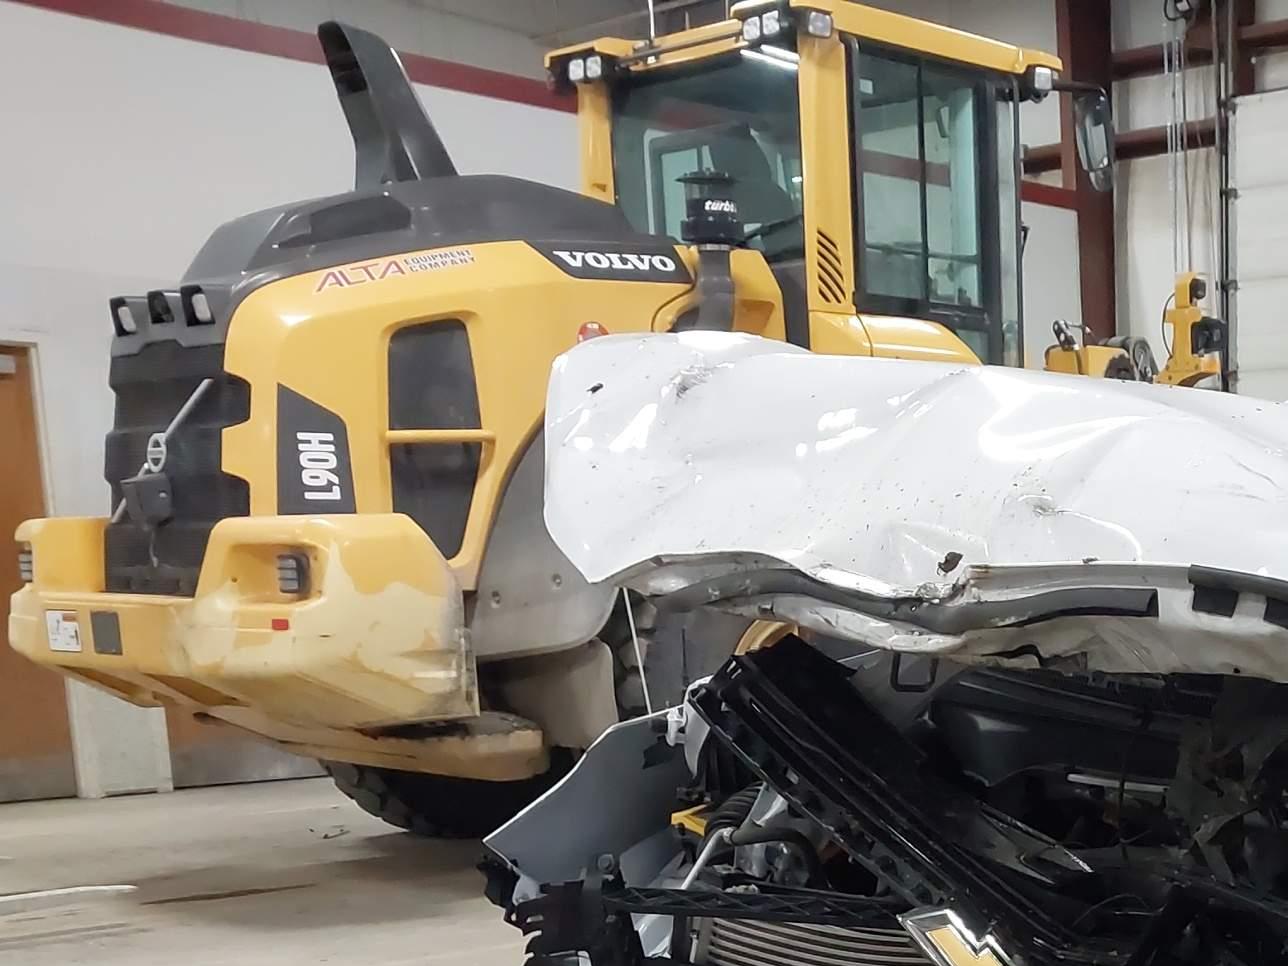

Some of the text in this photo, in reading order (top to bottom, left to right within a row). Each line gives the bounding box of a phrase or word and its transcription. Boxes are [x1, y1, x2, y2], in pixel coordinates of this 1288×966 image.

[404, 250, 471, 265] EQUIPMENT
[409, 257, 476, 272] COMPANY
[553, 251, 675, 271] VOLVO
[316, 260, 405, 292] ALTA
[297, 432, 341, 500] L90H
